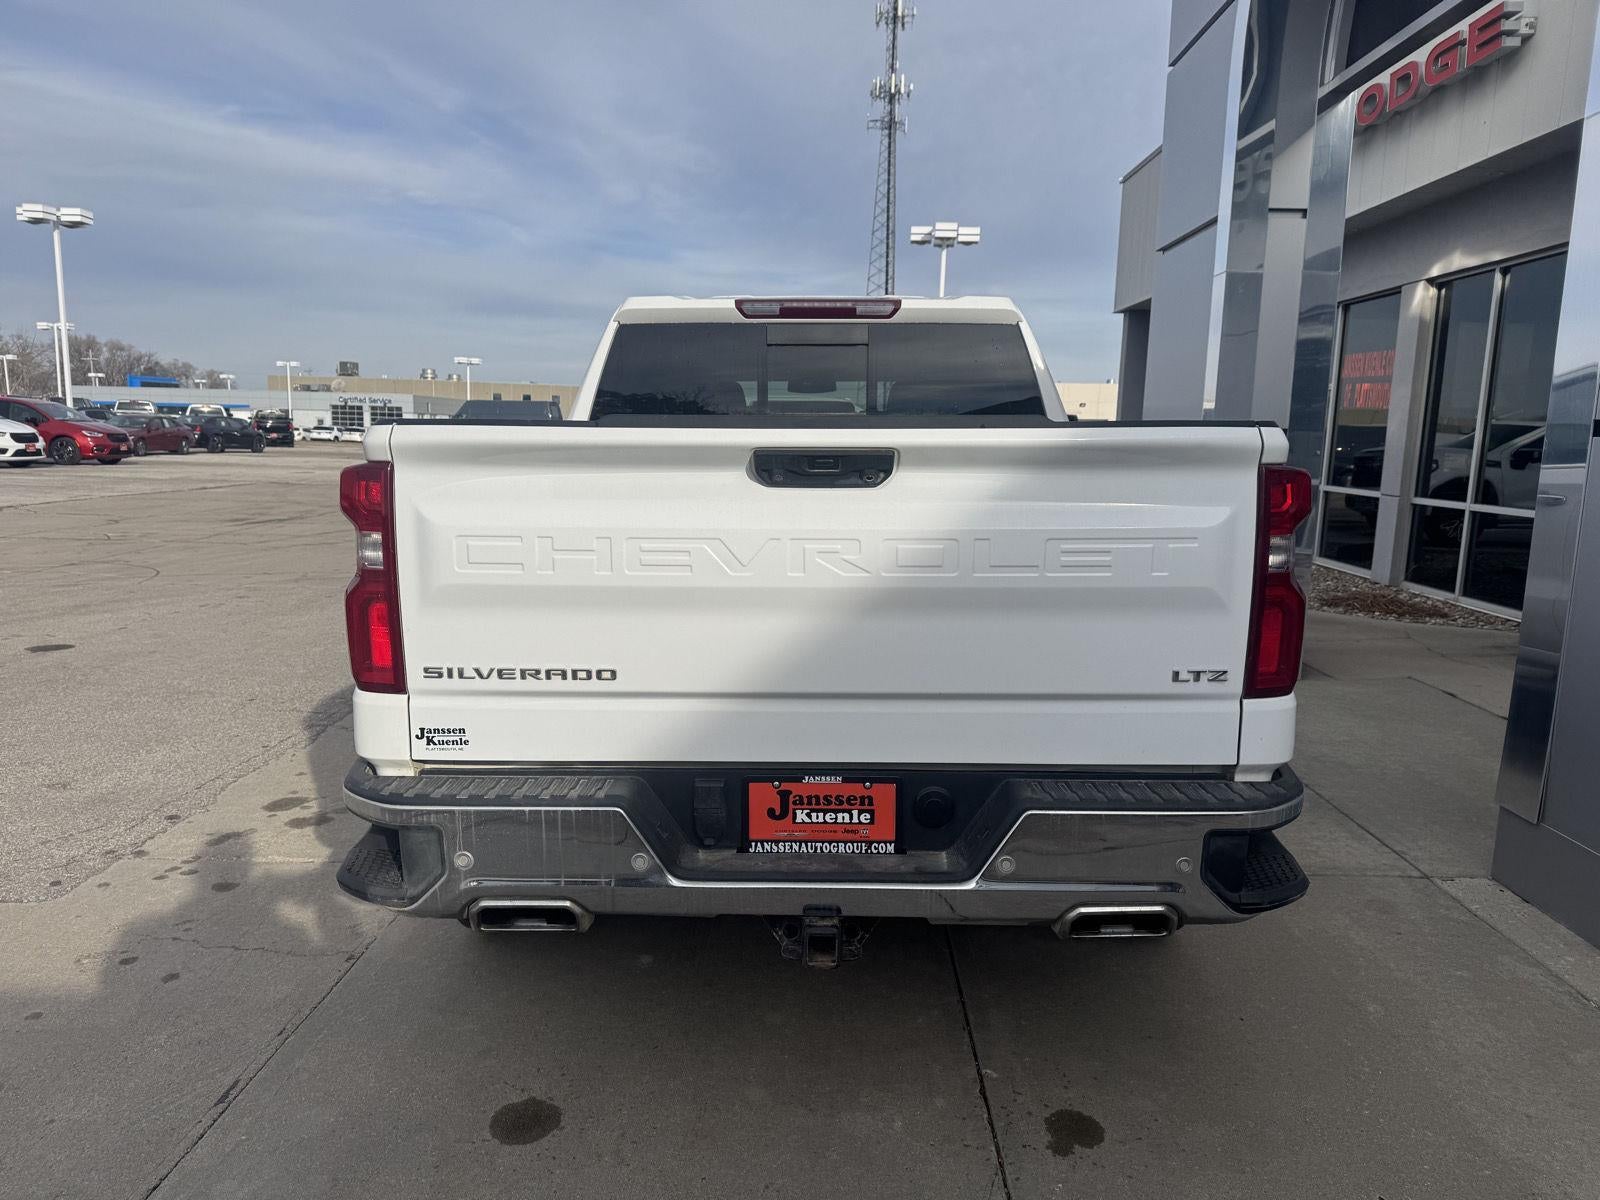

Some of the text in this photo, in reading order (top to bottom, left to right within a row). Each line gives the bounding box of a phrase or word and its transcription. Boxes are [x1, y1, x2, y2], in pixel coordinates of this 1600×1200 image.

[1355, 2, 1505, 126] ODGE
[368, 396, 392, 404] Service
[453, 535, 1199, 576] CHEVROLET
[423, 666, 618, 681] SILVERADO
[1172, 670, 1228, 682] LTZ
[415, 727, 466, 740] Janssen
[426, 736, 470, 746] Kuenle
[767, 789, 875, 821] Janssen
[795, 809, 871, 824] Kuenle
